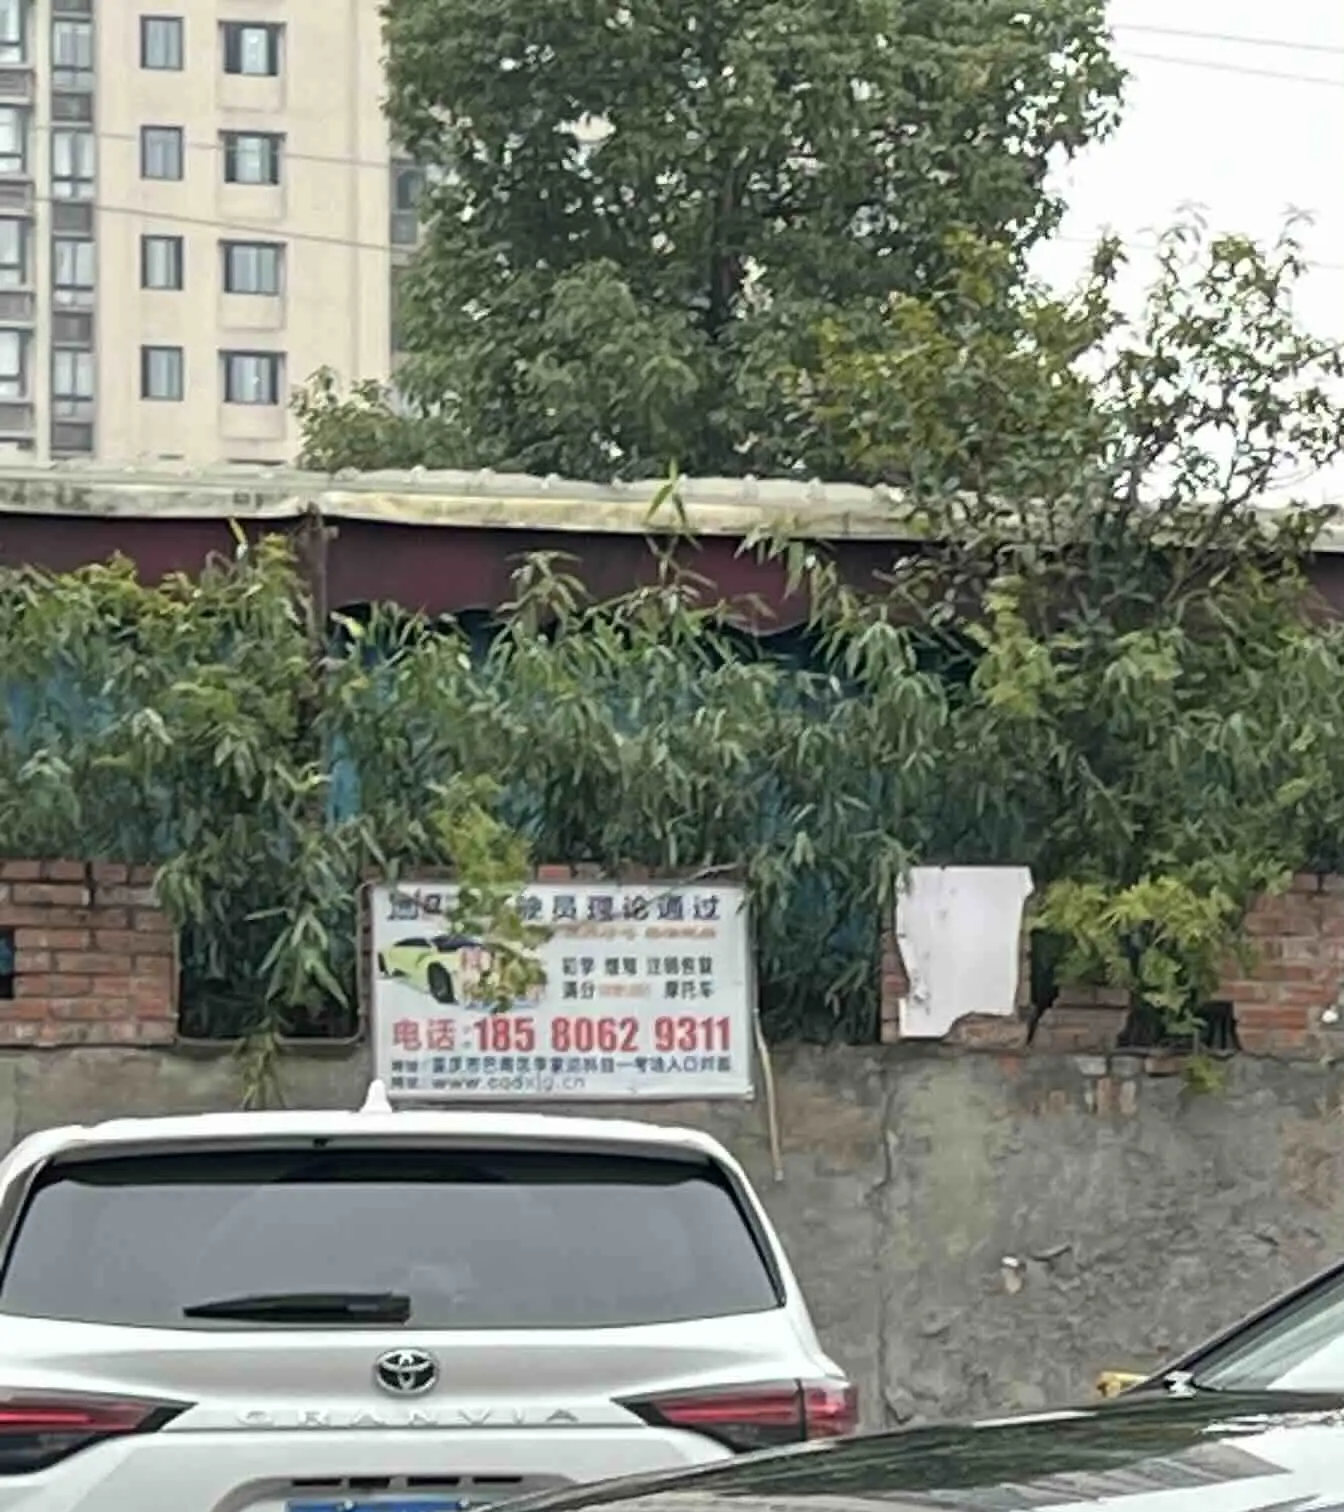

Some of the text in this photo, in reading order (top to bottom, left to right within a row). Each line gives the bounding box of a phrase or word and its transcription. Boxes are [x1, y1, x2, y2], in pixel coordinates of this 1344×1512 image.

[471, 1016, 536, 1053] 185
[551, 1016, 639, 1053] 8062
[655, 1016, 731, 1053] 9311
